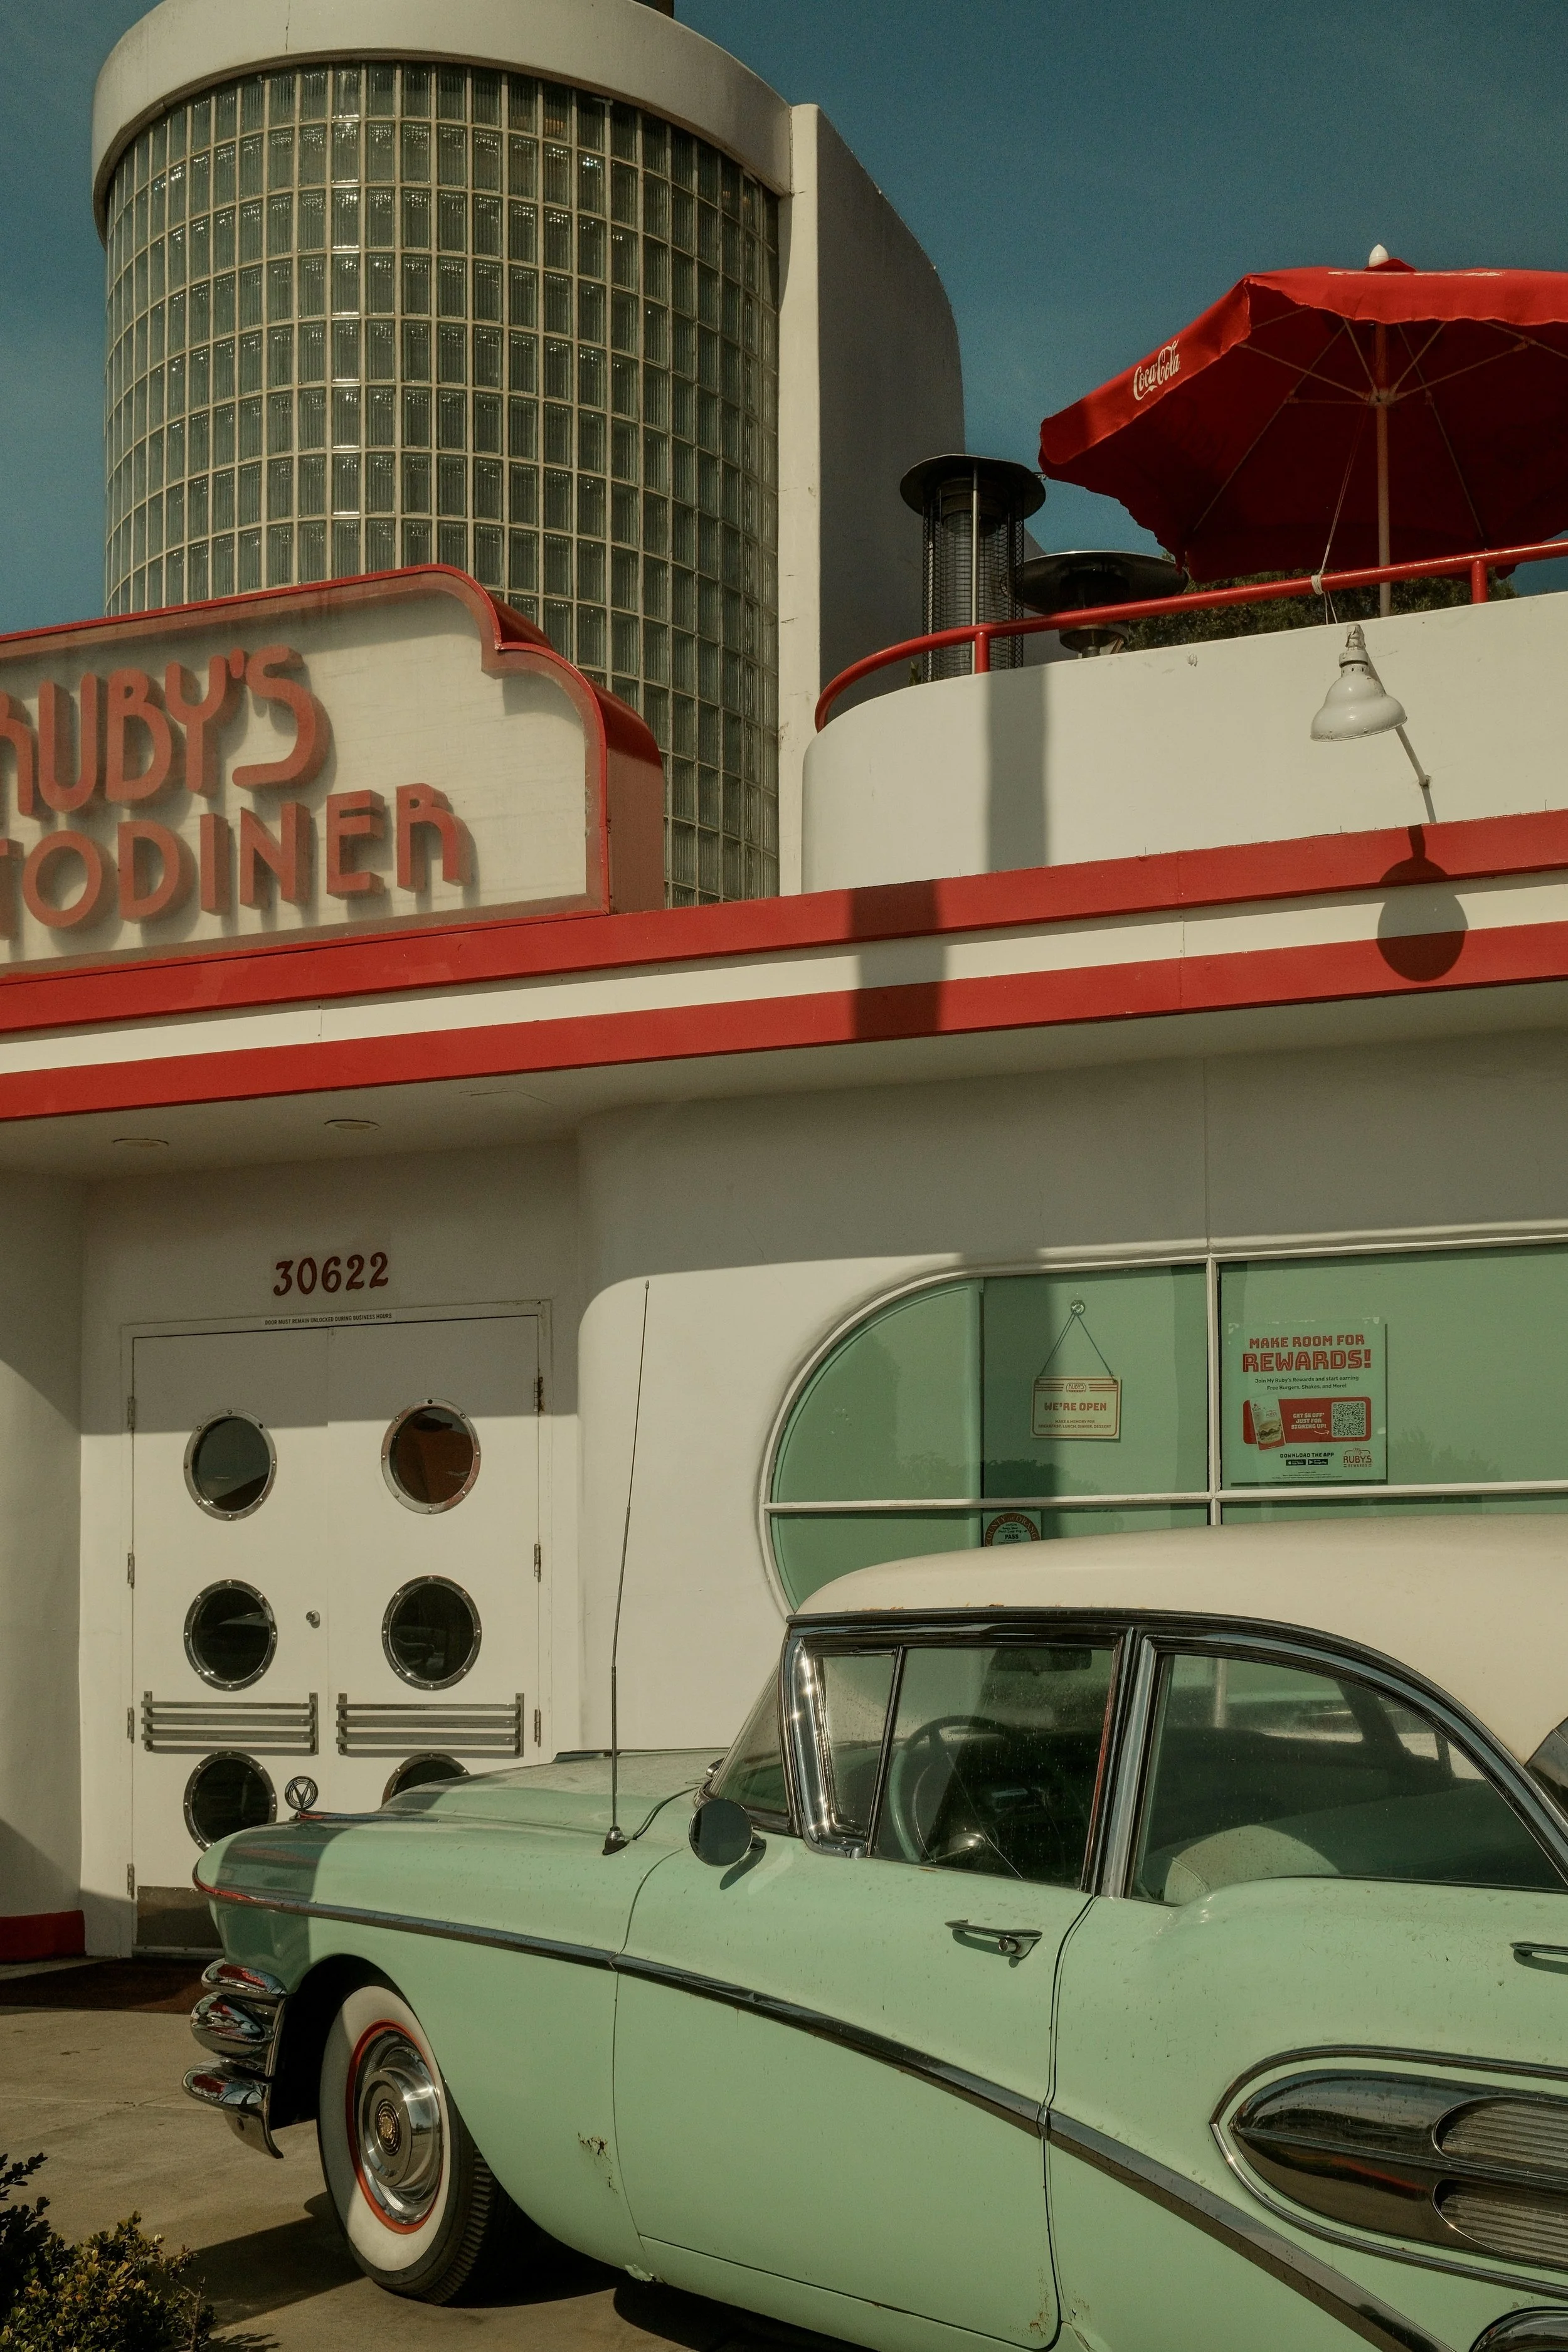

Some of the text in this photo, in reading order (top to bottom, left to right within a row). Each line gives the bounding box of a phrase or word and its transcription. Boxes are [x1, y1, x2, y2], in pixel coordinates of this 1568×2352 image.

[273, 1251, 389, 1296] 30622
[1249, 1334, 1365, 1348] MAKE ROOM FOR
[1242, 1349, 1371, 1372] REWARDS!
[1044, 1402, 1107, 1411] WE'RE OPEN
[986, 1517, 1005, 1547] COUNTY
[1016, 1515, 1039, 1540] ORANG
